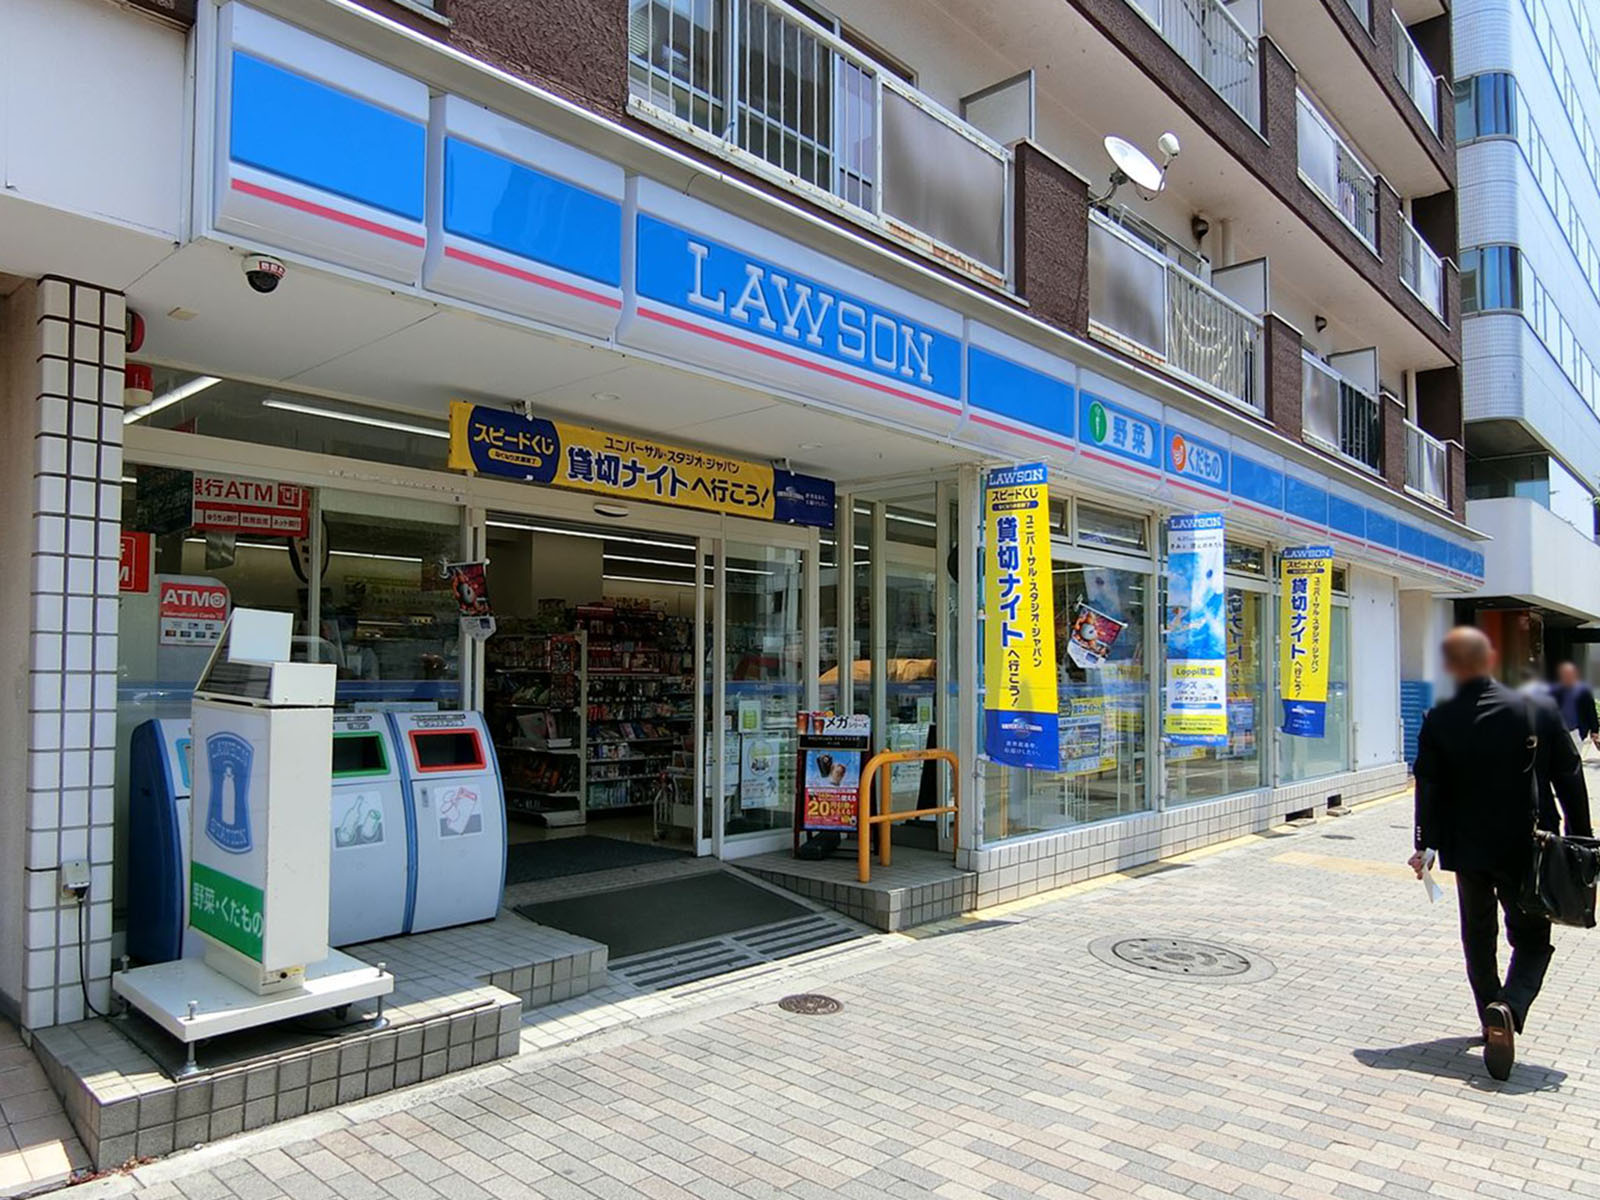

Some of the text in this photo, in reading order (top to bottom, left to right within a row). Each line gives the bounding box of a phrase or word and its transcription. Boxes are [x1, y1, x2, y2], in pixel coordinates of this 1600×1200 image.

[687, 242, 933, 384] LAWSON
[473, 423, 555, 455] スピードくじ
[1112, 415, 1146, 454] 野菜
[1187, 446, 1220, 480] くだもの
[988, 468, 1044, 486] LAWSON
[992, 487, 1039, 502] スピードくじ
[1170, 516, 1222, 529] LAWSON
[1284, 549, 1331, 558] LAWSON
[162, 589, 209, 607] ATM
[826, 716, 849, 729] メガ
[192, 882, 264, 938] 野菜・くだもの
